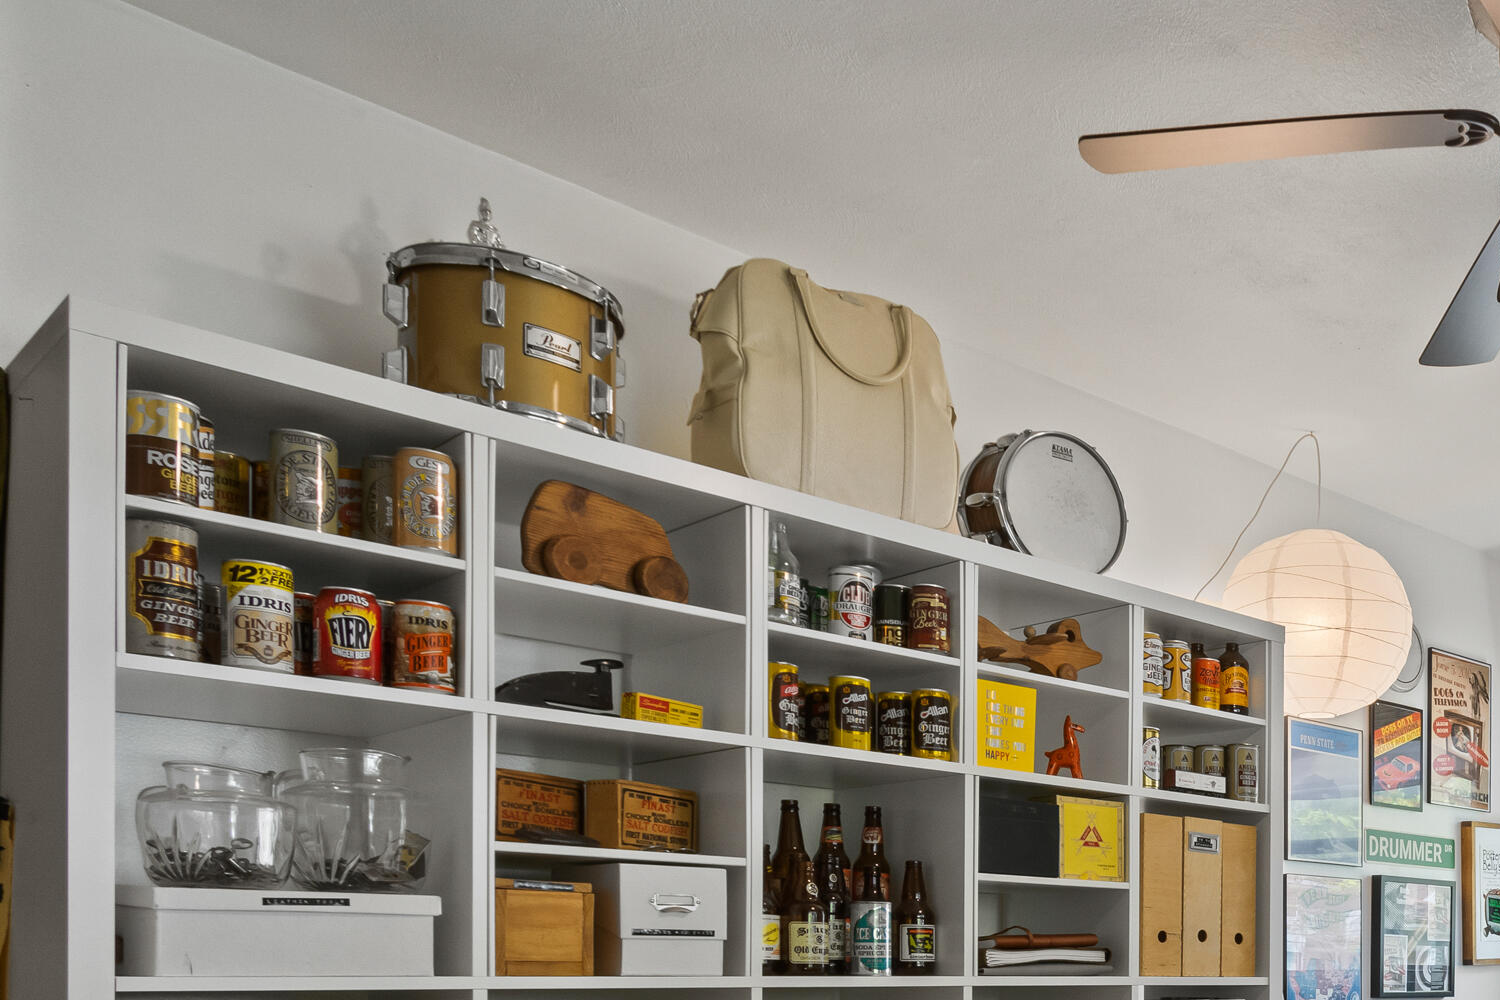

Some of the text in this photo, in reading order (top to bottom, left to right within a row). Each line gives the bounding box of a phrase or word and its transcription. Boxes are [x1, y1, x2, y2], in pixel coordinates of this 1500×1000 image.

[238, 594, 291, 614] IDRIS
[335, 593, 370, 607] IDRIS
[153, 613, 196, 630] BEER
[235, 614, 293, 635] GINGER
[408, 615, 449, 631] IDRIS
[245, 628, 289, 649] BEER
[327, 616, 375, 650] FIERY
[407, 633, 449, 653] GINGER
[411, 653, 445, 673] BEER
[1434, 687, 1454, 698] DOGS
[1300, 734, 1335, 750] PENN STATE
[985, 749, 1010, 761] HAPPY
[1368, 835, 1453, 863] DRUMMER DR
